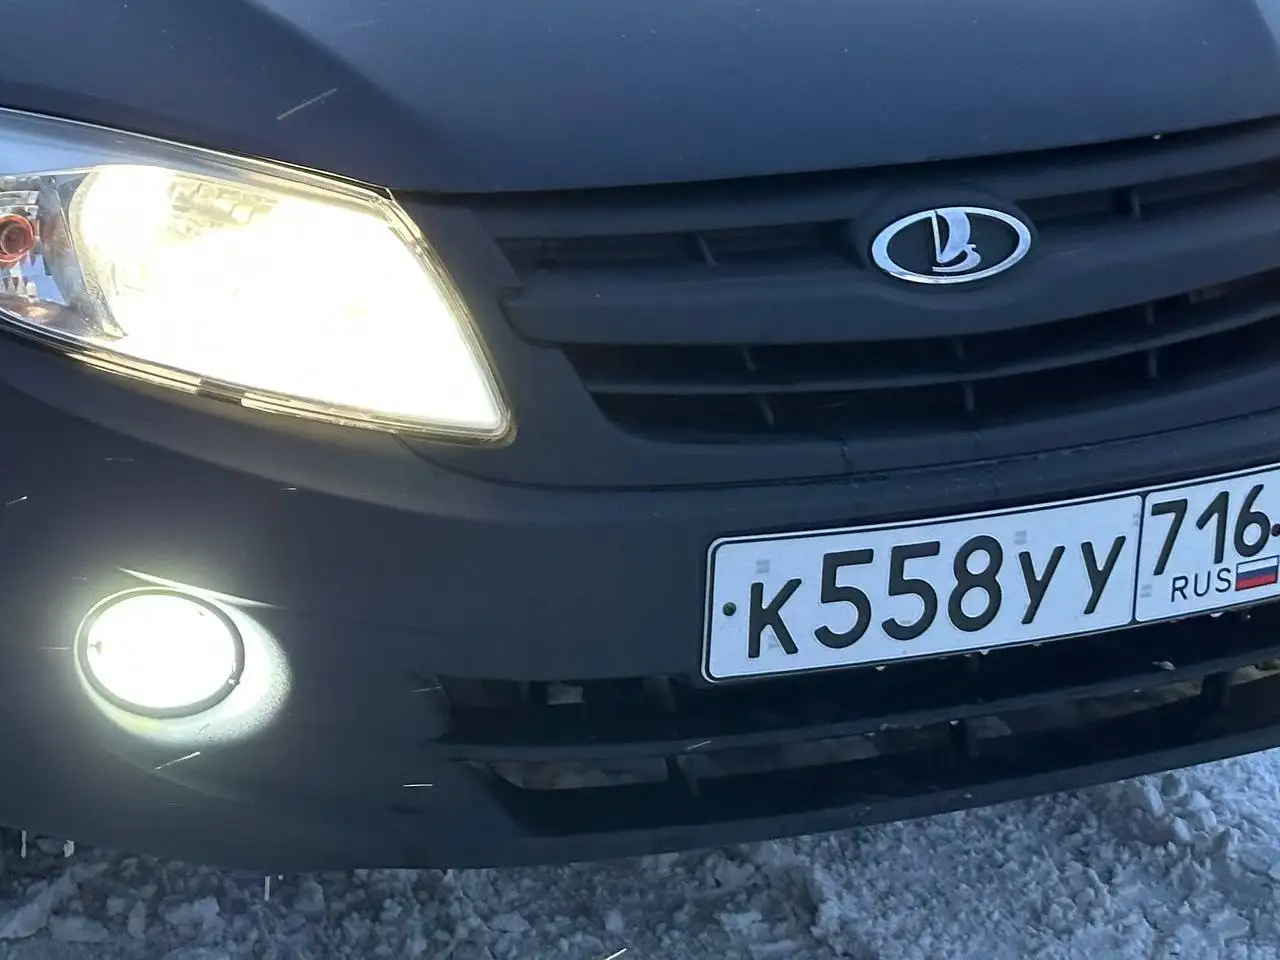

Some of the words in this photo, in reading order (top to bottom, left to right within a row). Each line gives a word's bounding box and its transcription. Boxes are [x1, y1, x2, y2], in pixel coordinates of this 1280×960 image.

[747, 535, 1127, 659] К558УУ
[1150, 483, 1271, 576] 716
[1170, 567, 1232, 603] RUS
